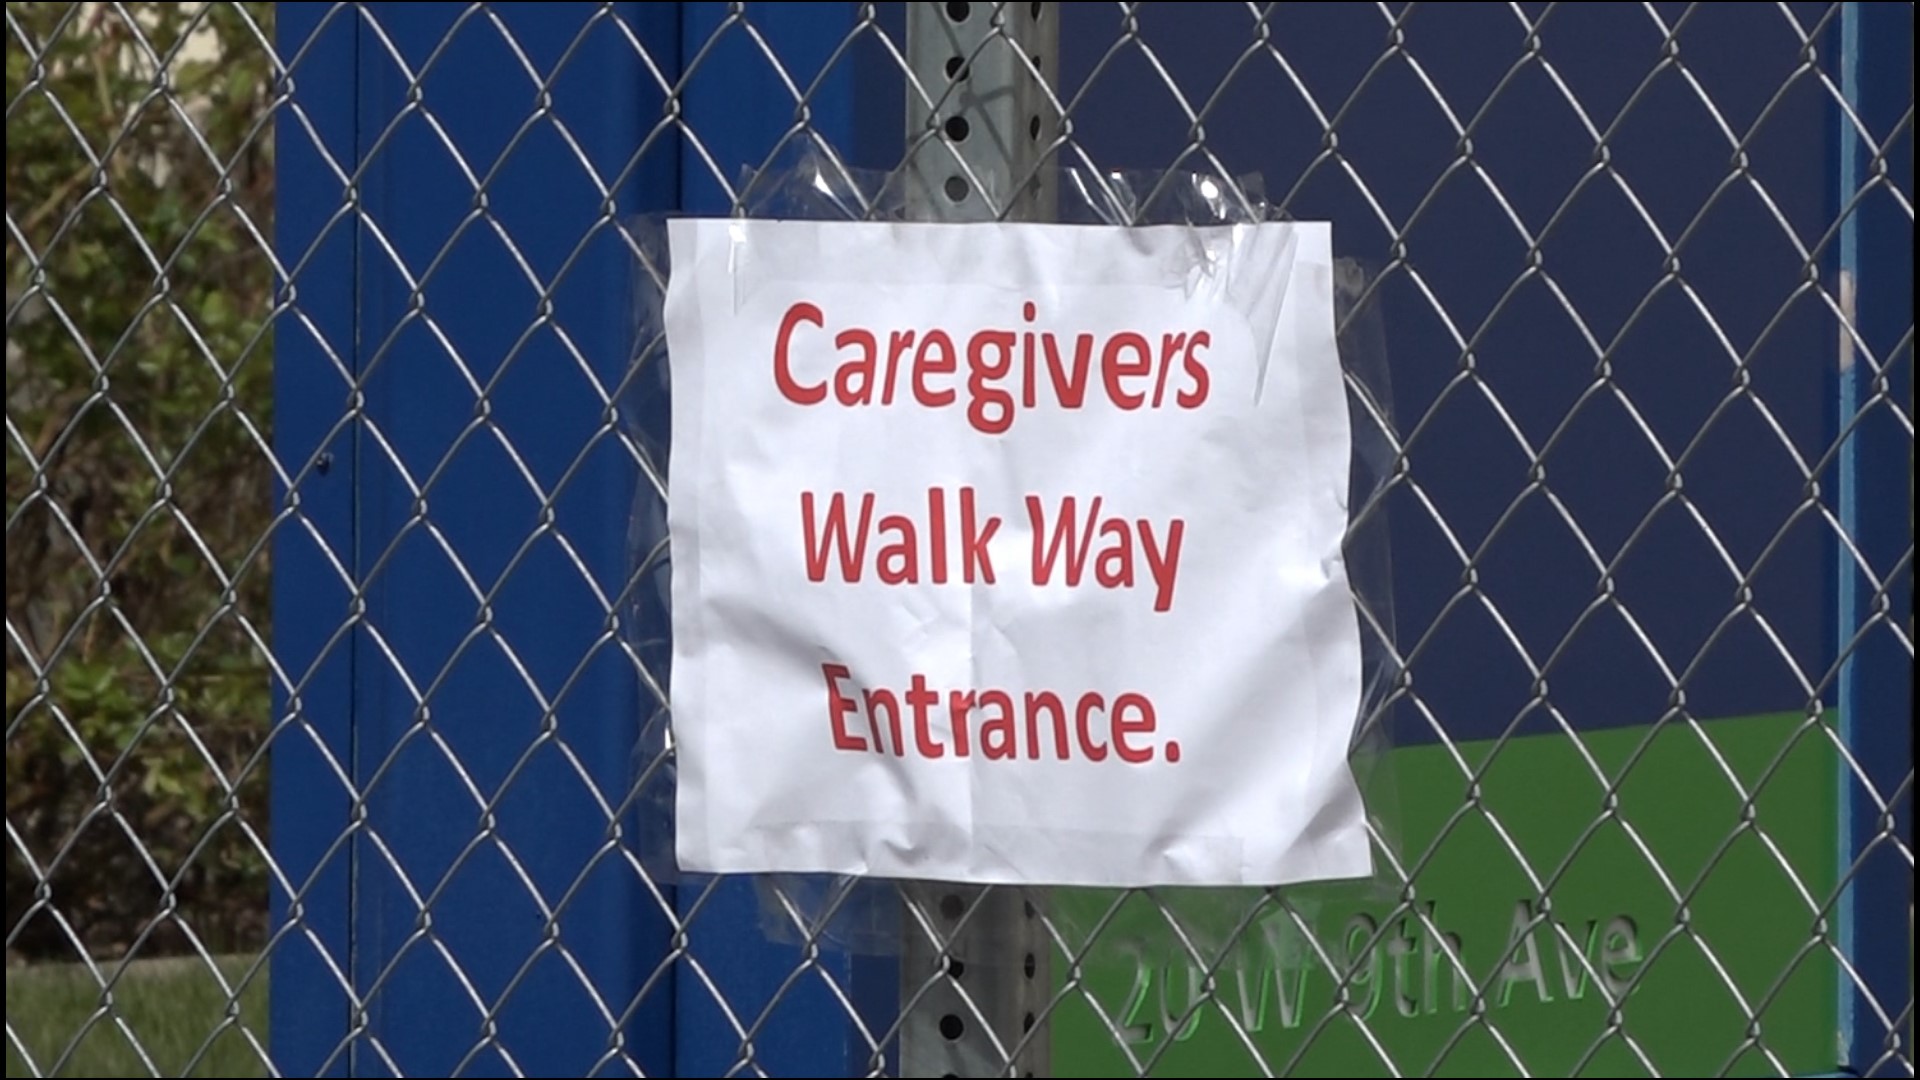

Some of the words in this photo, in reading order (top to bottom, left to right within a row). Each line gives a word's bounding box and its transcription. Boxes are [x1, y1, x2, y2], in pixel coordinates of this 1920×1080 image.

[773, 302, 1211, 435] Caregivers
[801, 487, 1001, 585] Walk
[1026, 495, 1185, 613] Way
[821, 663, 1181, 764] Entrance.
[1112, 938, 1200, 1044] 20
[1236, 912, 1316, 1033] W
[1341, 900, 1467, 1020] 9th
[1500, 899, 1645, 1008] Ave
